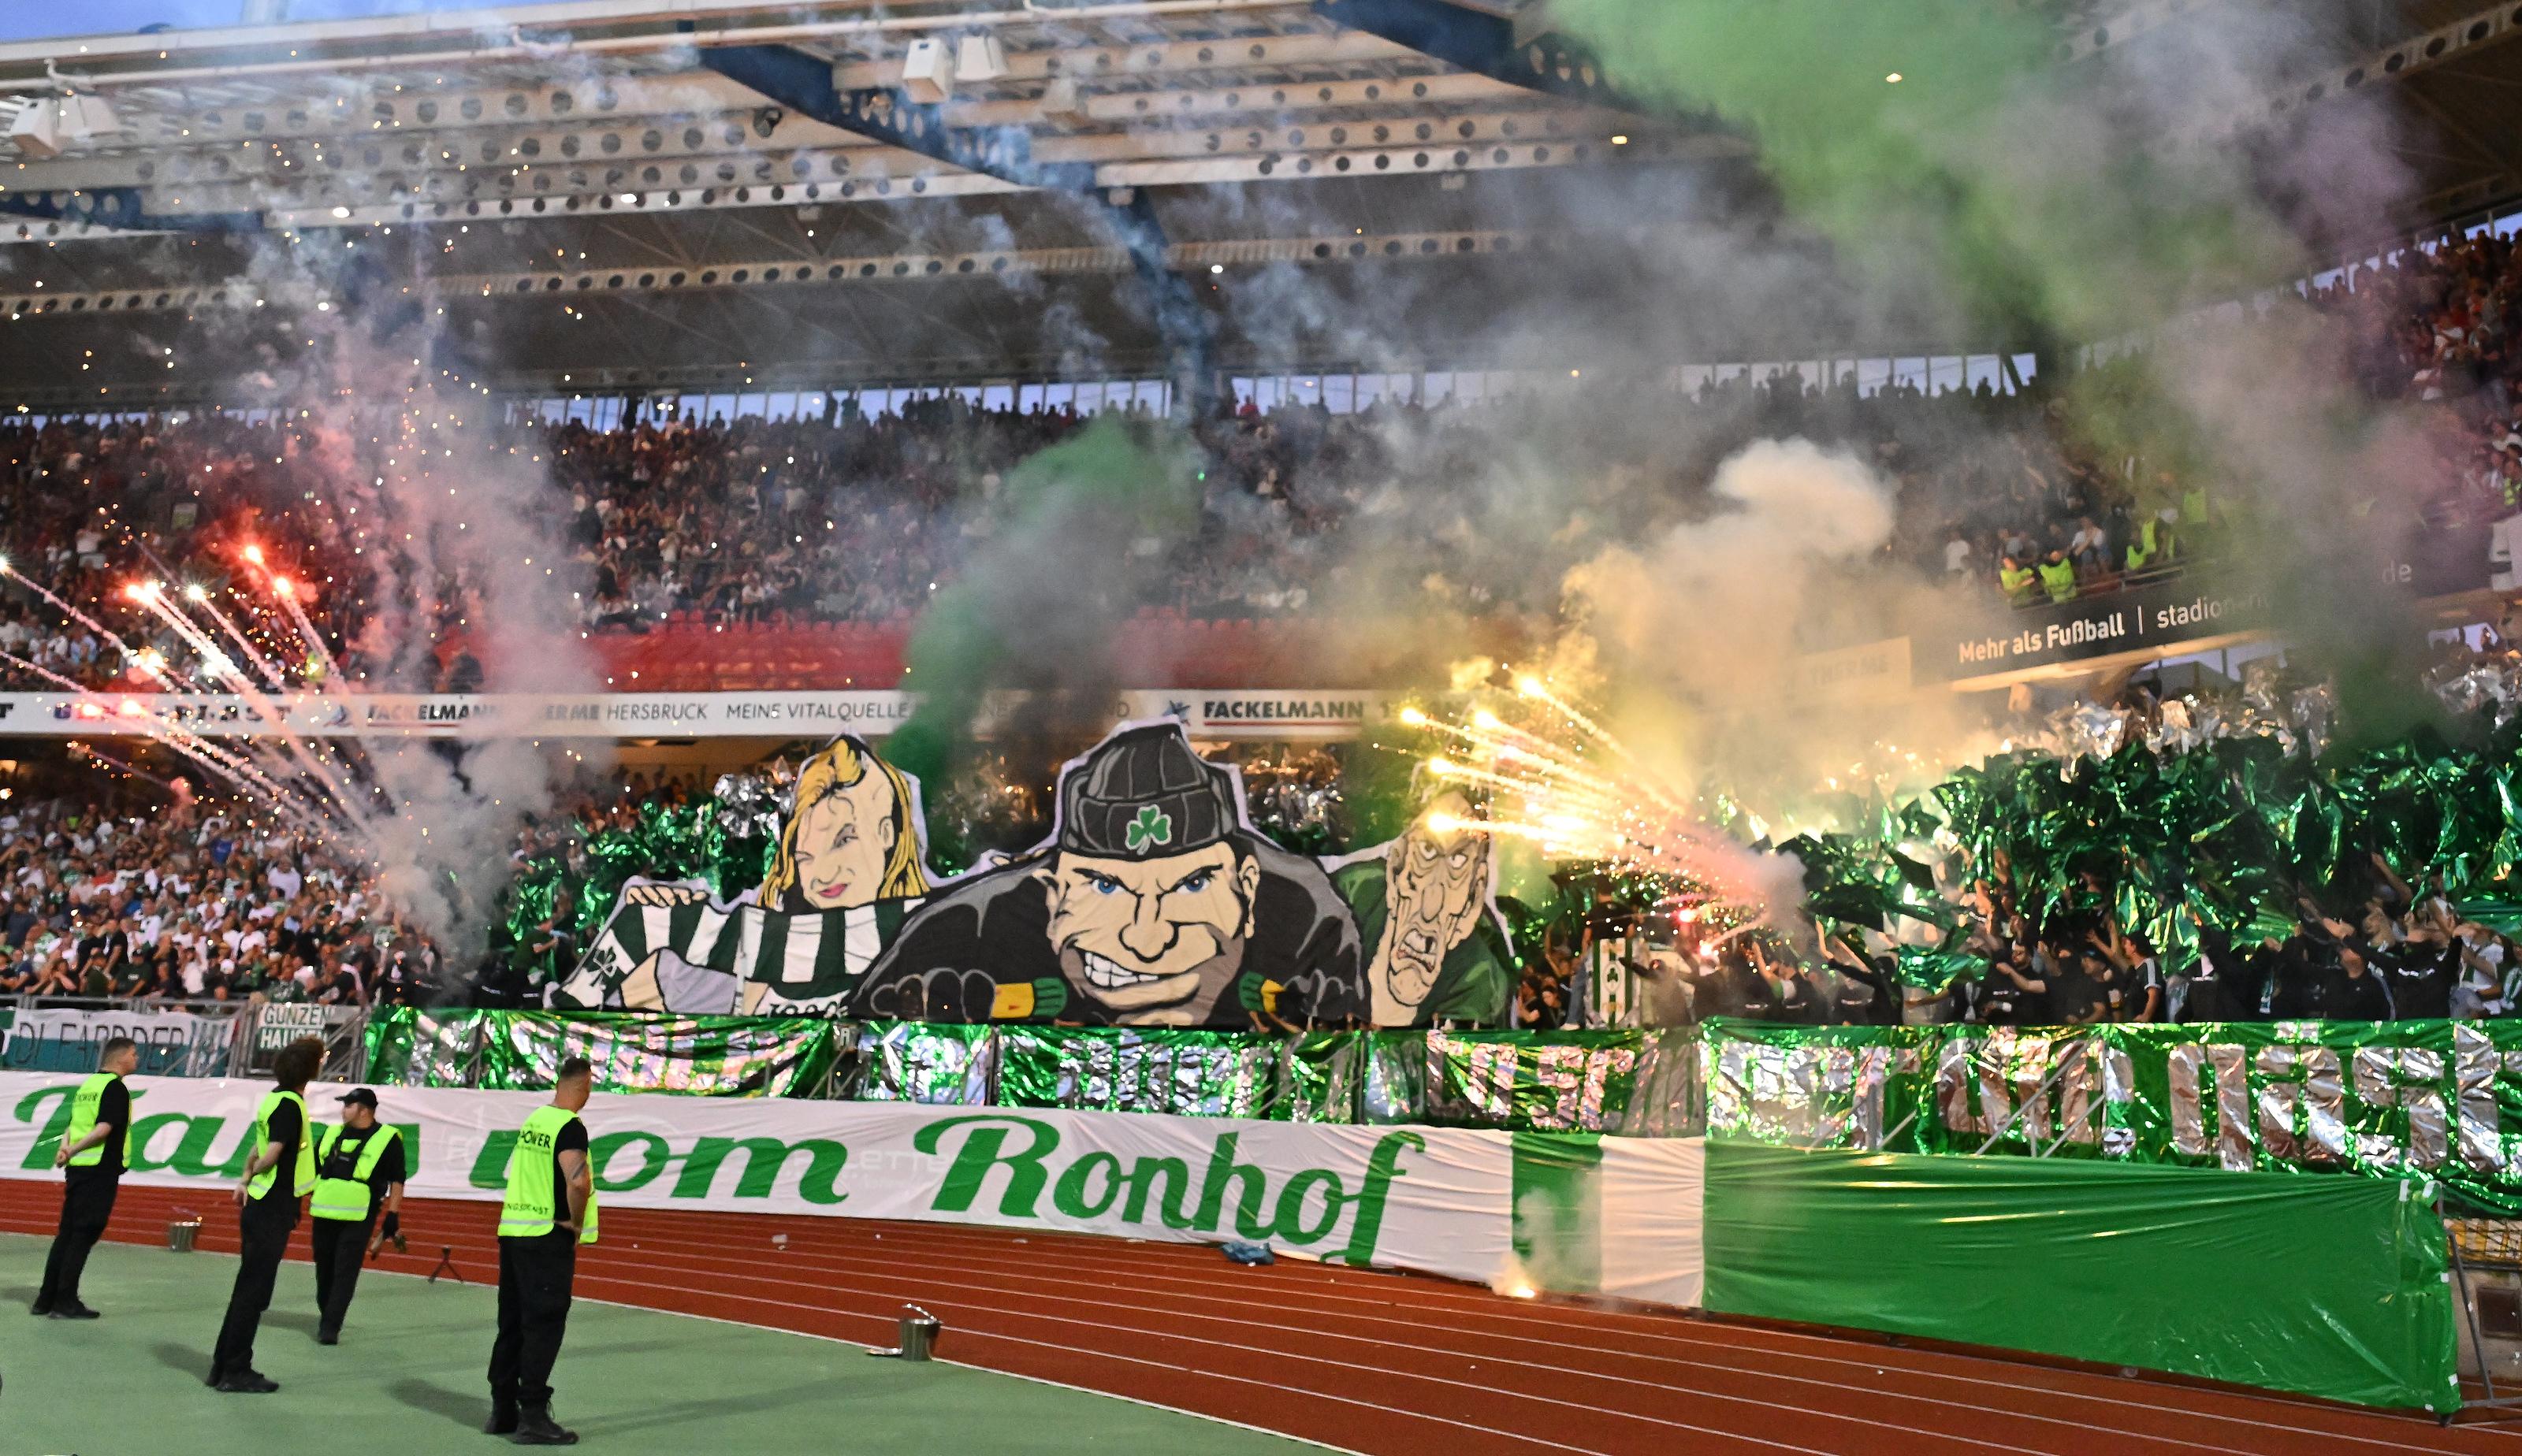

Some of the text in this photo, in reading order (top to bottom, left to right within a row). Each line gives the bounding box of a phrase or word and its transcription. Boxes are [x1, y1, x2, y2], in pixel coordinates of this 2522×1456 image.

[1958, 641, 2007, 664] Mehr
[2012, 630, 2043, 655] als
[2046, 611, 2126, 650] Fußball
[544, 704, 600, 721] ERME
[607, 703, 709, 721] HERSBRUCK
[726, 703, 780, 719] MEINE
[787, 702, 909, 722] VITALQUELLE
[1203, 700, 1364, 719] FACKELMANN
[913, 1114, 1427, 1268] Ronhof
